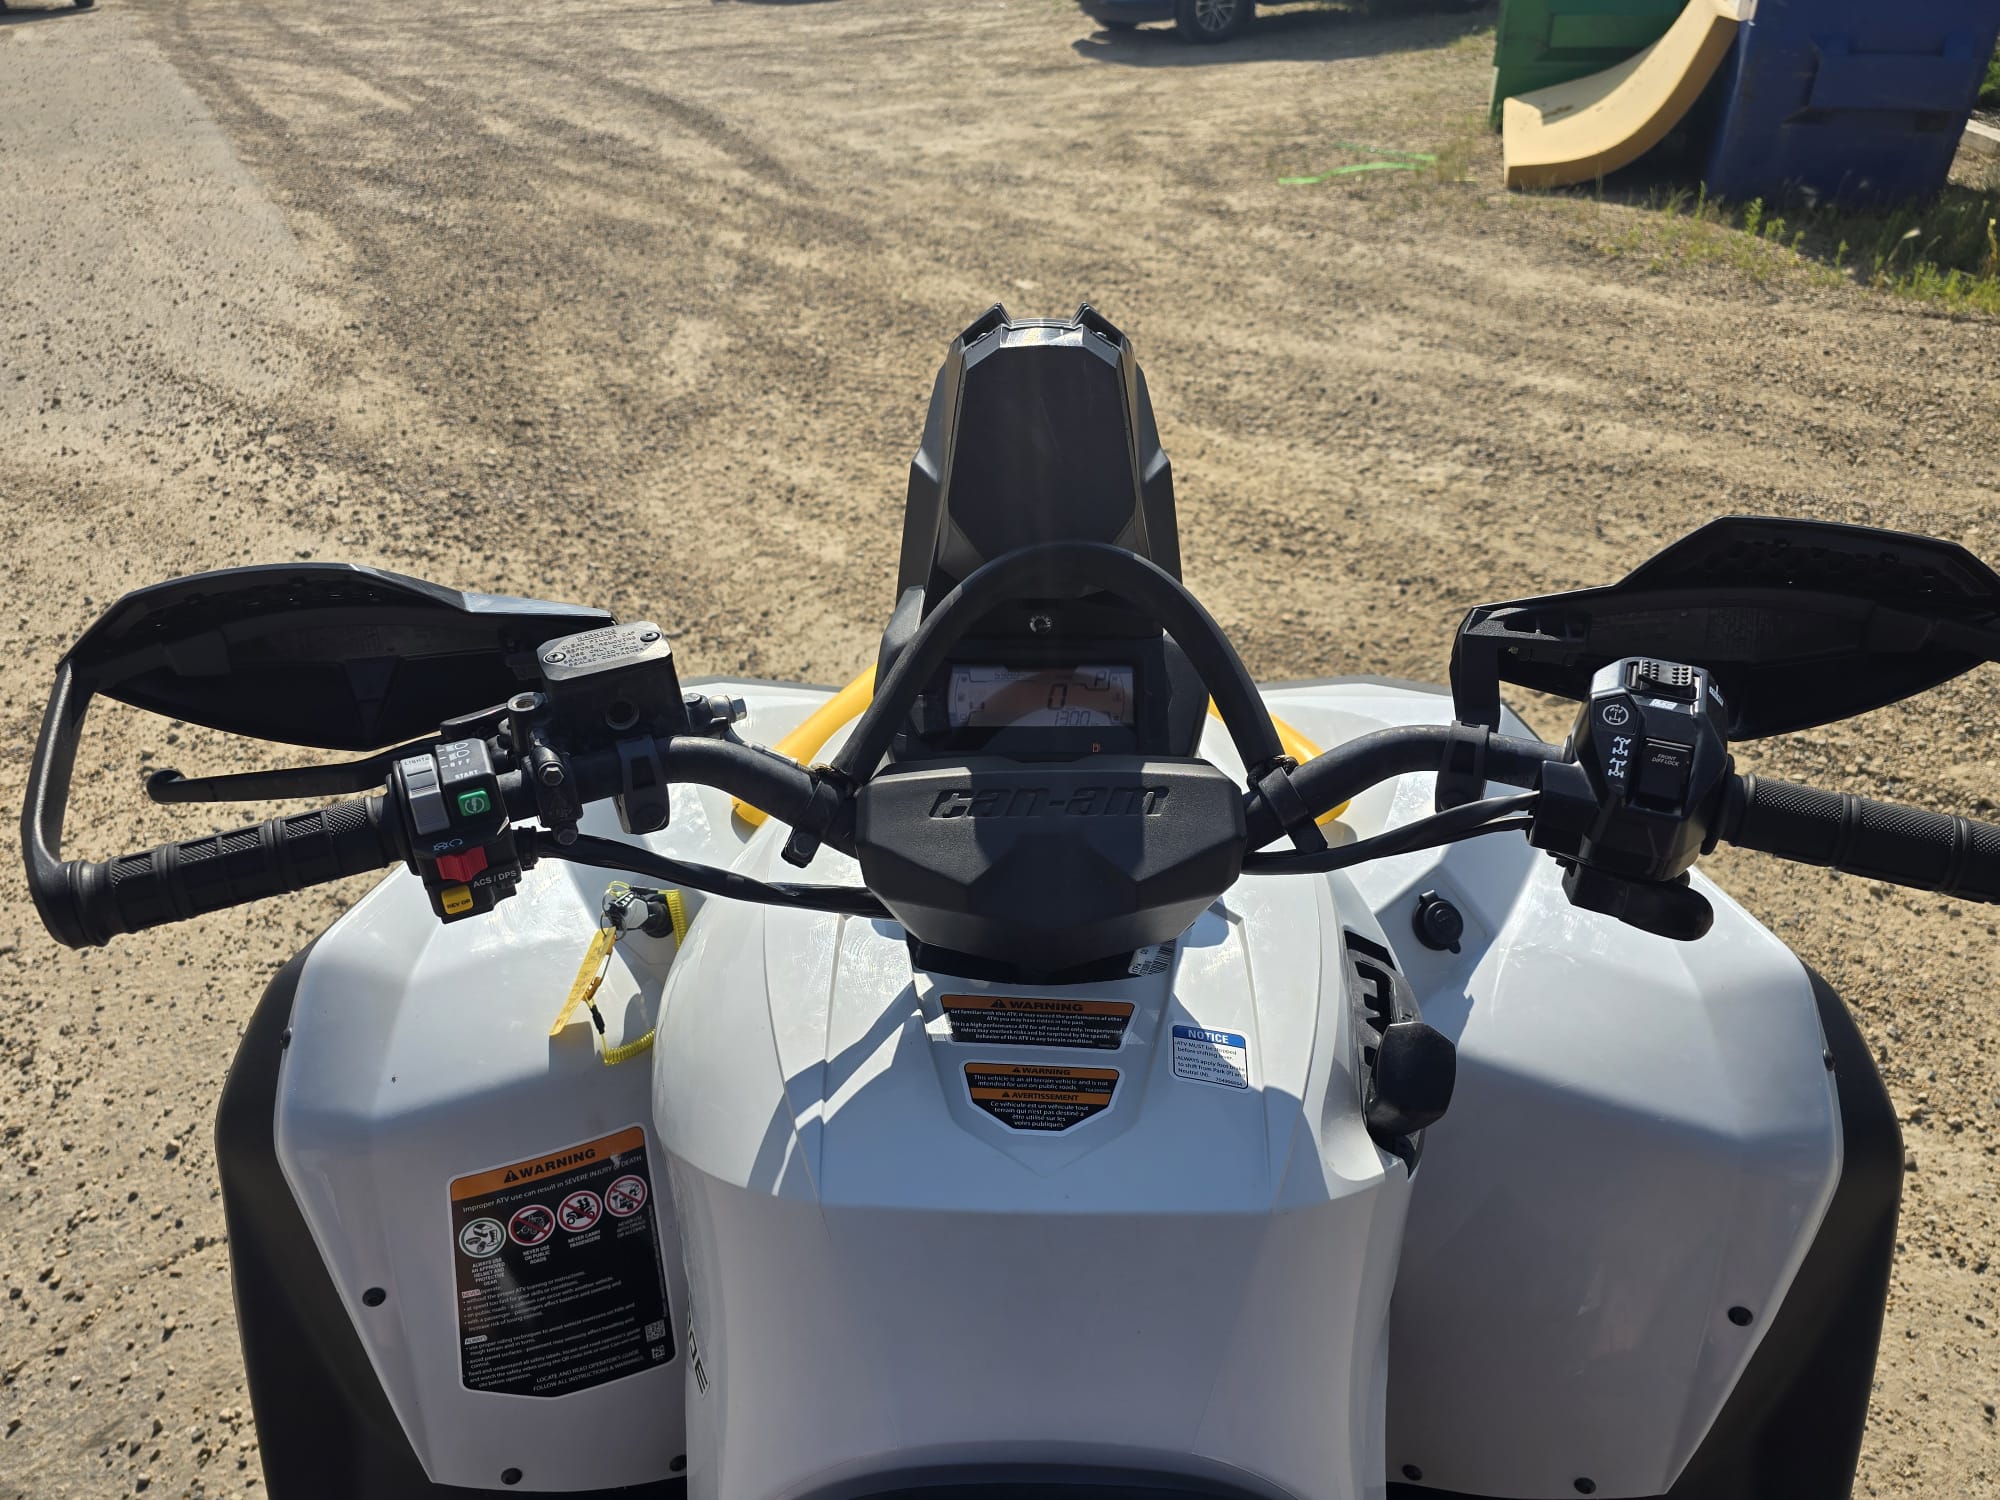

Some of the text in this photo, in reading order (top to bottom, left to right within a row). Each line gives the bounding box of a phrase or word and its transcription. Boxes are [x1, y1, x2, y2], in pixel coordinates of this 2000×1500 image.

[454, 770, 479, 780] START
[474, 877, 492, 888] ACS
[498, 870, 517, 880] DPS
[1010, 1001, 1083, 1012] WARNING
[1188, 1030, 1230, 1044] NOTICE
[1012, 1092, 1079, 1101] AVERTISSEMENT
[519, 1148, 596, 1178] WARNING
[463, 1201, 494, 1213] Improper
[496, 1196, 509, 1205] ATV
[538, 1184, 556, 1194] result
[564, 1173, 588, 1186] SEVERE
[590, 1166, 612, 1178] INJURY
